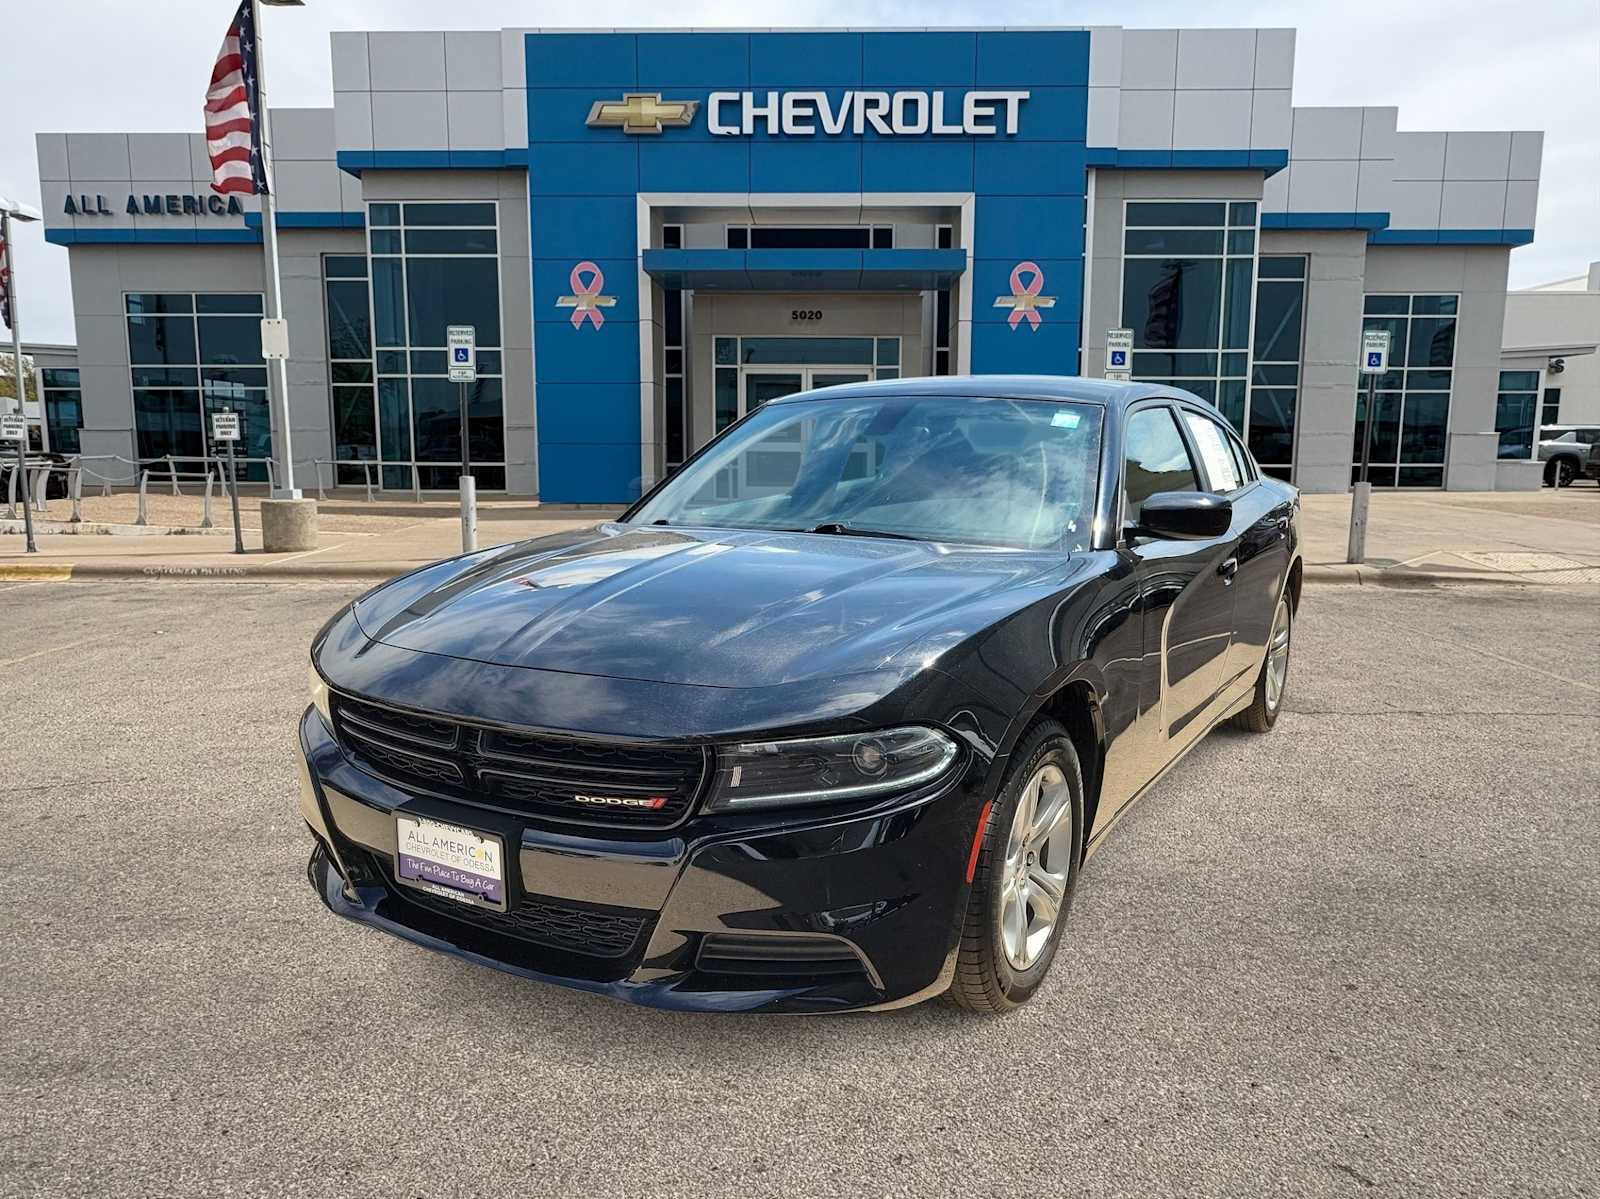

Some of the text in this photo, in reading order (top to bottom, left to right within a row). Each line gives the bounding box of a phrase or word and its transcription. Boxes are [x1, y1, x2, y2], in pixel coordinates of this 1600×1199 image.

[707, 91, 1030, 135] CHEVROLET
[64, 194, 113, 215] ALL
[791, 310, 823, 321] 5020
[575, 795, 655, 808] DODGE
[408, 830, 428, 845] ALL
[407, 858, 419, 870] The
[420, 862, 432, 873] Fun
[432, 865, 450, 879] Place
[451, 871, 460, 881] To
[460, 874, 475, 889] Buy
[482, 880, 496, 891] Car
